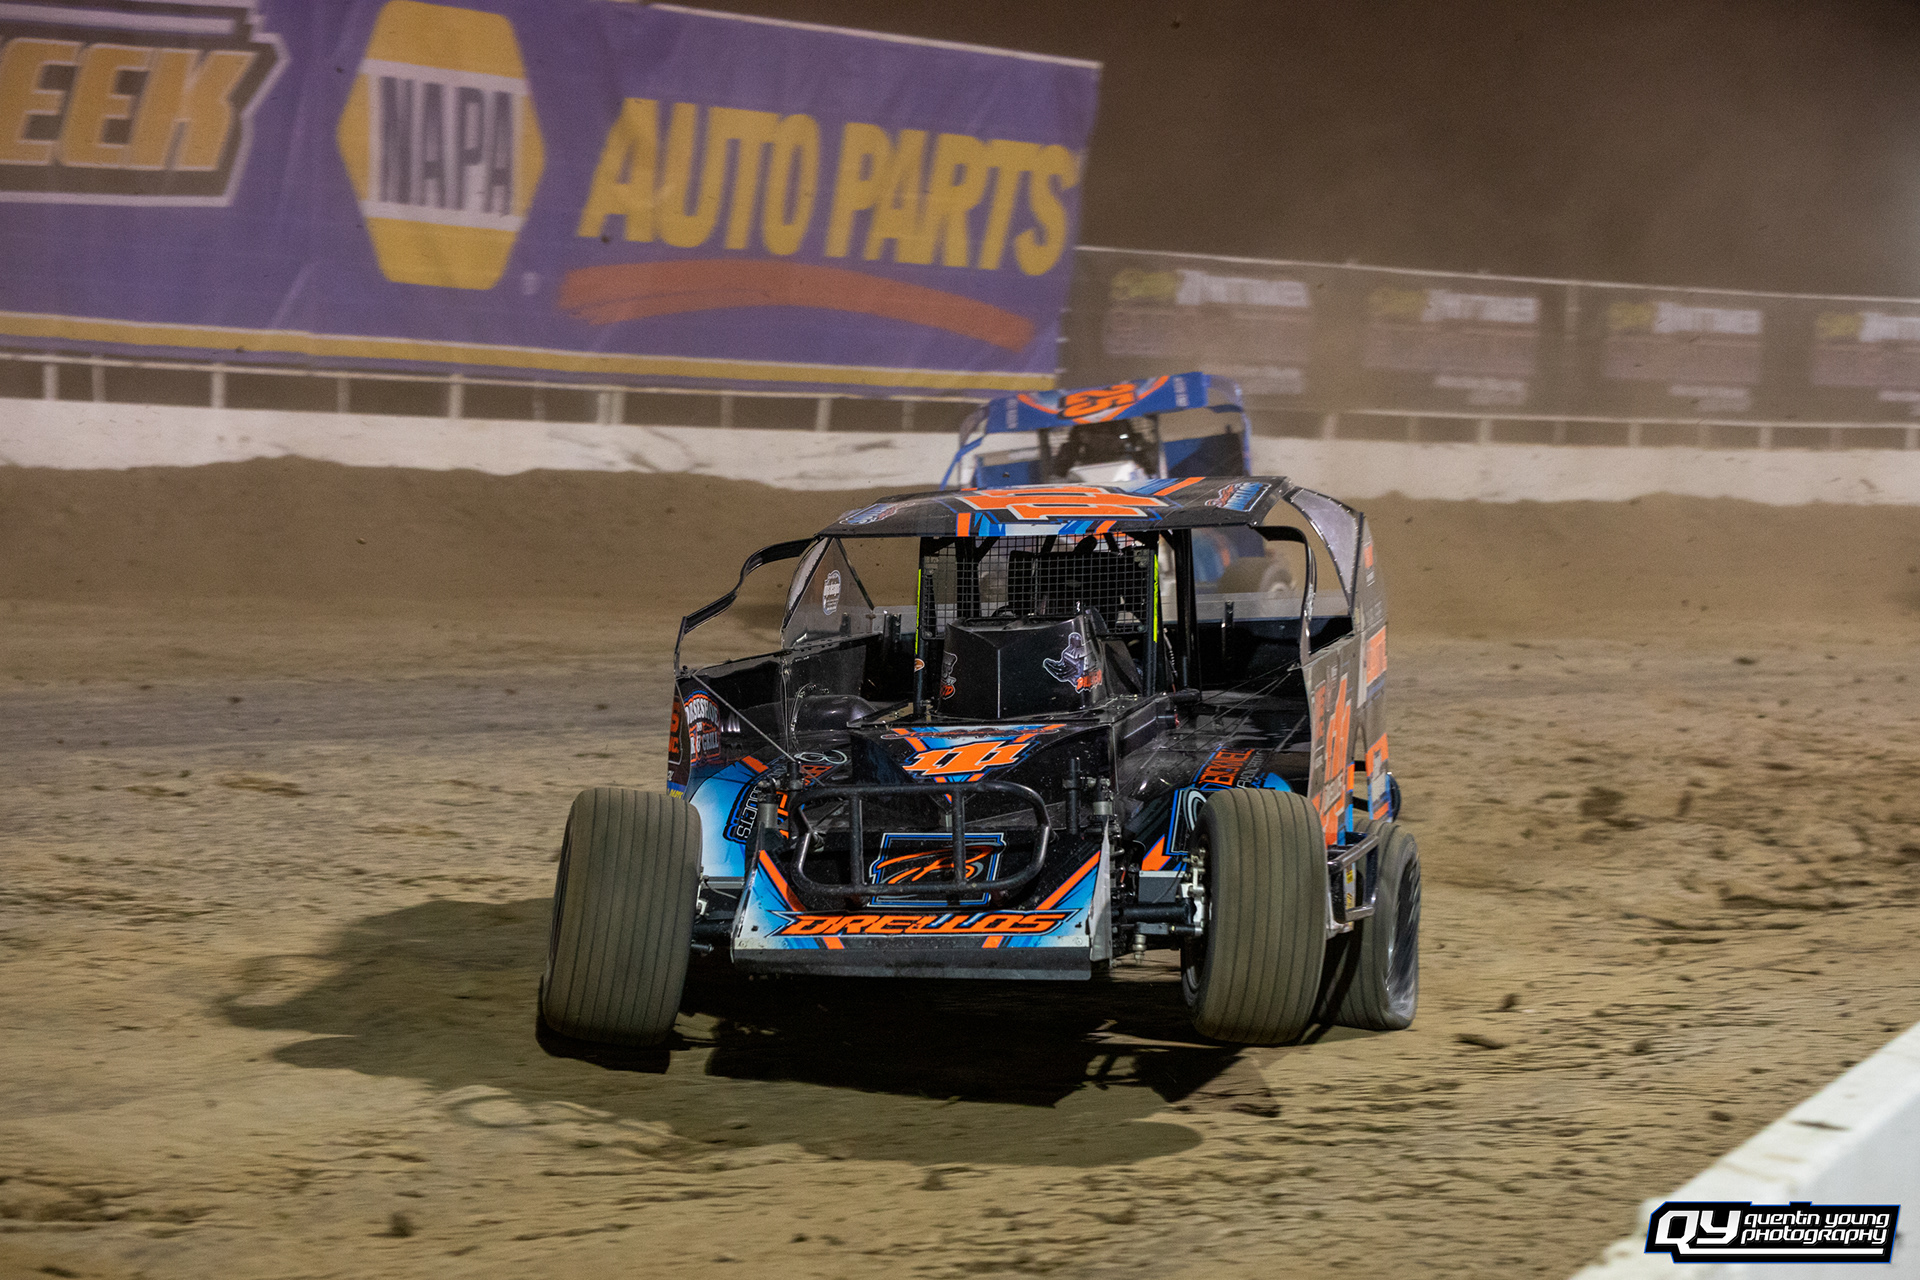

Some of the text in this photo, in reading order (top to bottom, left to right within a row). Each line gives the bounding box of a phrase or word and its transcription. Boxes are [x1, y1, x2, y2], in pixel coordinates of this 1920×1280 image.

[379, 76, 513, 216] NAPA
[577, 98, 1080, 276] AUTO PARTS
[902, 741, 1030, 775] 111
